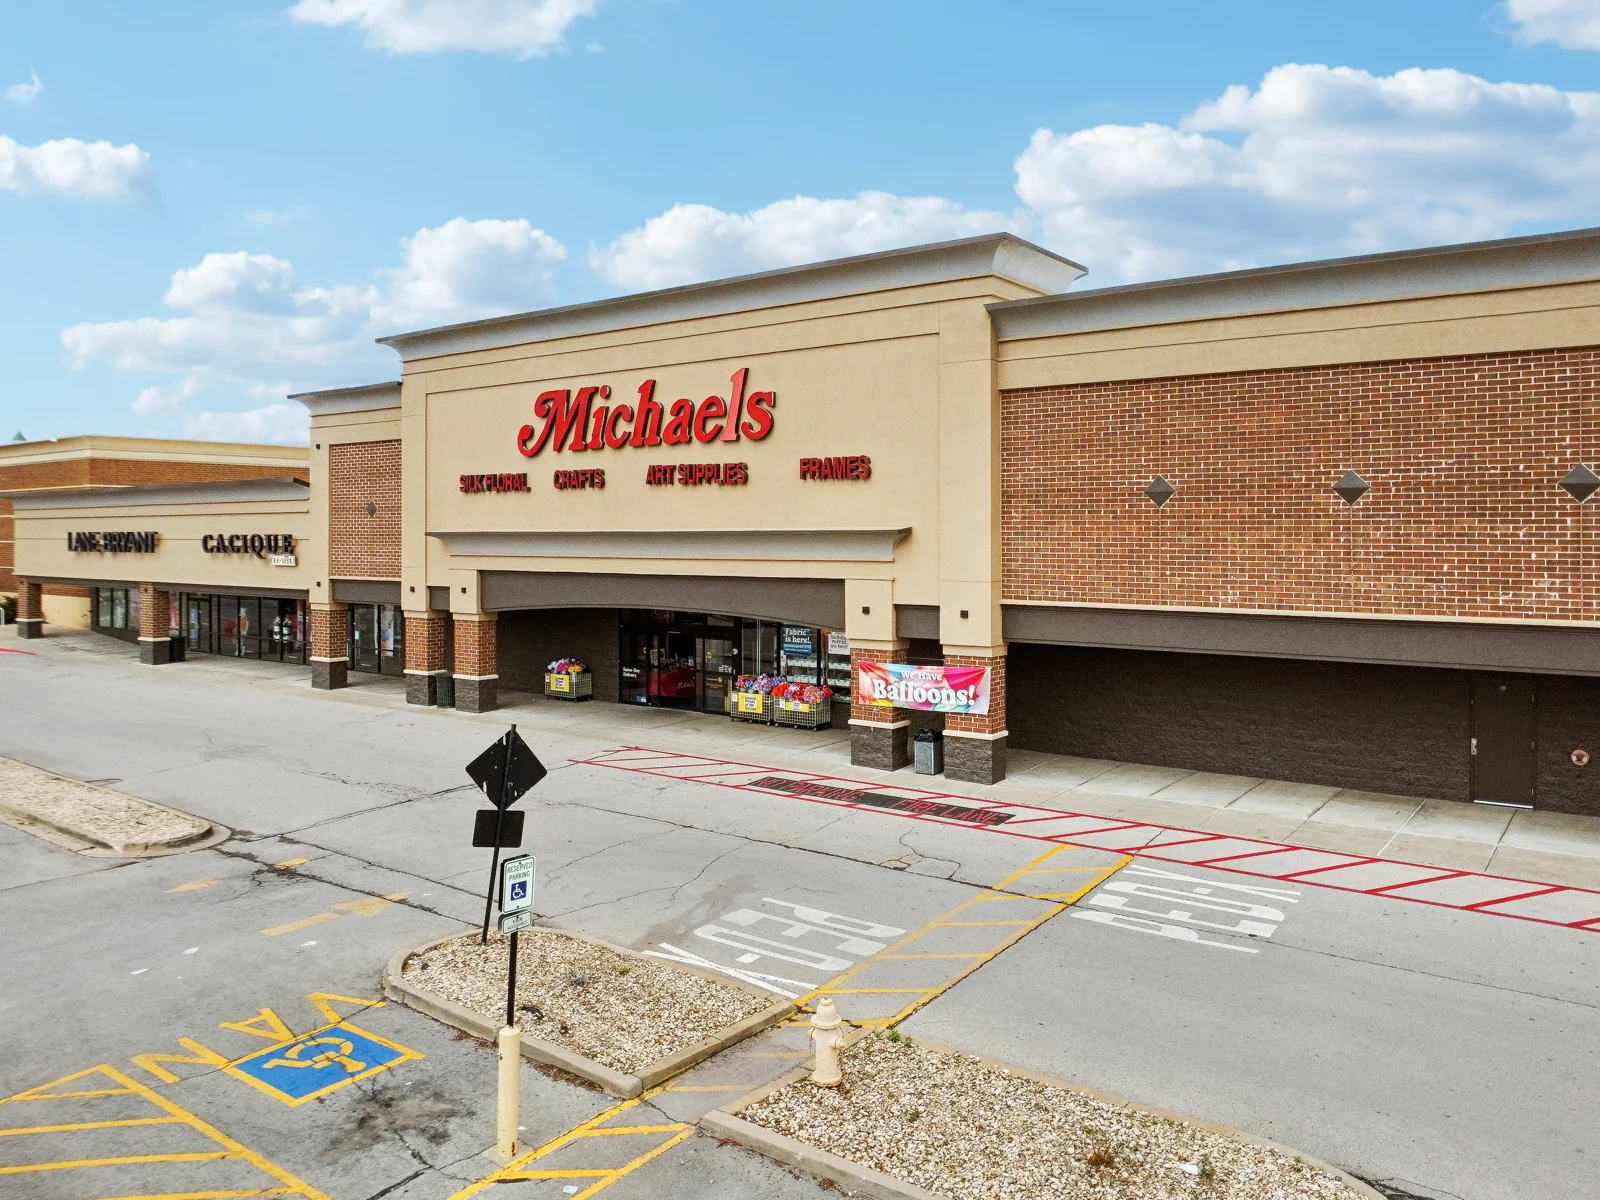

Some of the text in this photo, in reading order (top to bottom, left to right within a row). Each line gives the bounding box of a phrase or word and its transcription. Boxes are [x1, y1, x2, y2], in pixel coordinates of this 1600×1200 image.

[518, 368, 776, 457] Michaels
[646, 462, 748, 486] ART SUPPLIES
[800, 455, 871, 480] FRAMES
[459, 473, 531, 493] SILK FLORAL
[553, 468, 605, 490] CRAFTS
[67, 531, 159, 553] LANE BRYANT
[201, 533, 296, 560] CACIQUE
[785, 628, 807, 636] Fabric
[785, 635, 791, 643] is
[901, 669, 943, 681] We Have
[872, 679, 976, 706] Balloons!
[890, 799, 1009, 825] FIRE LANE
[507, 861, 533, 873] RESERVED
[508, 870, 531, 882] PARKING
